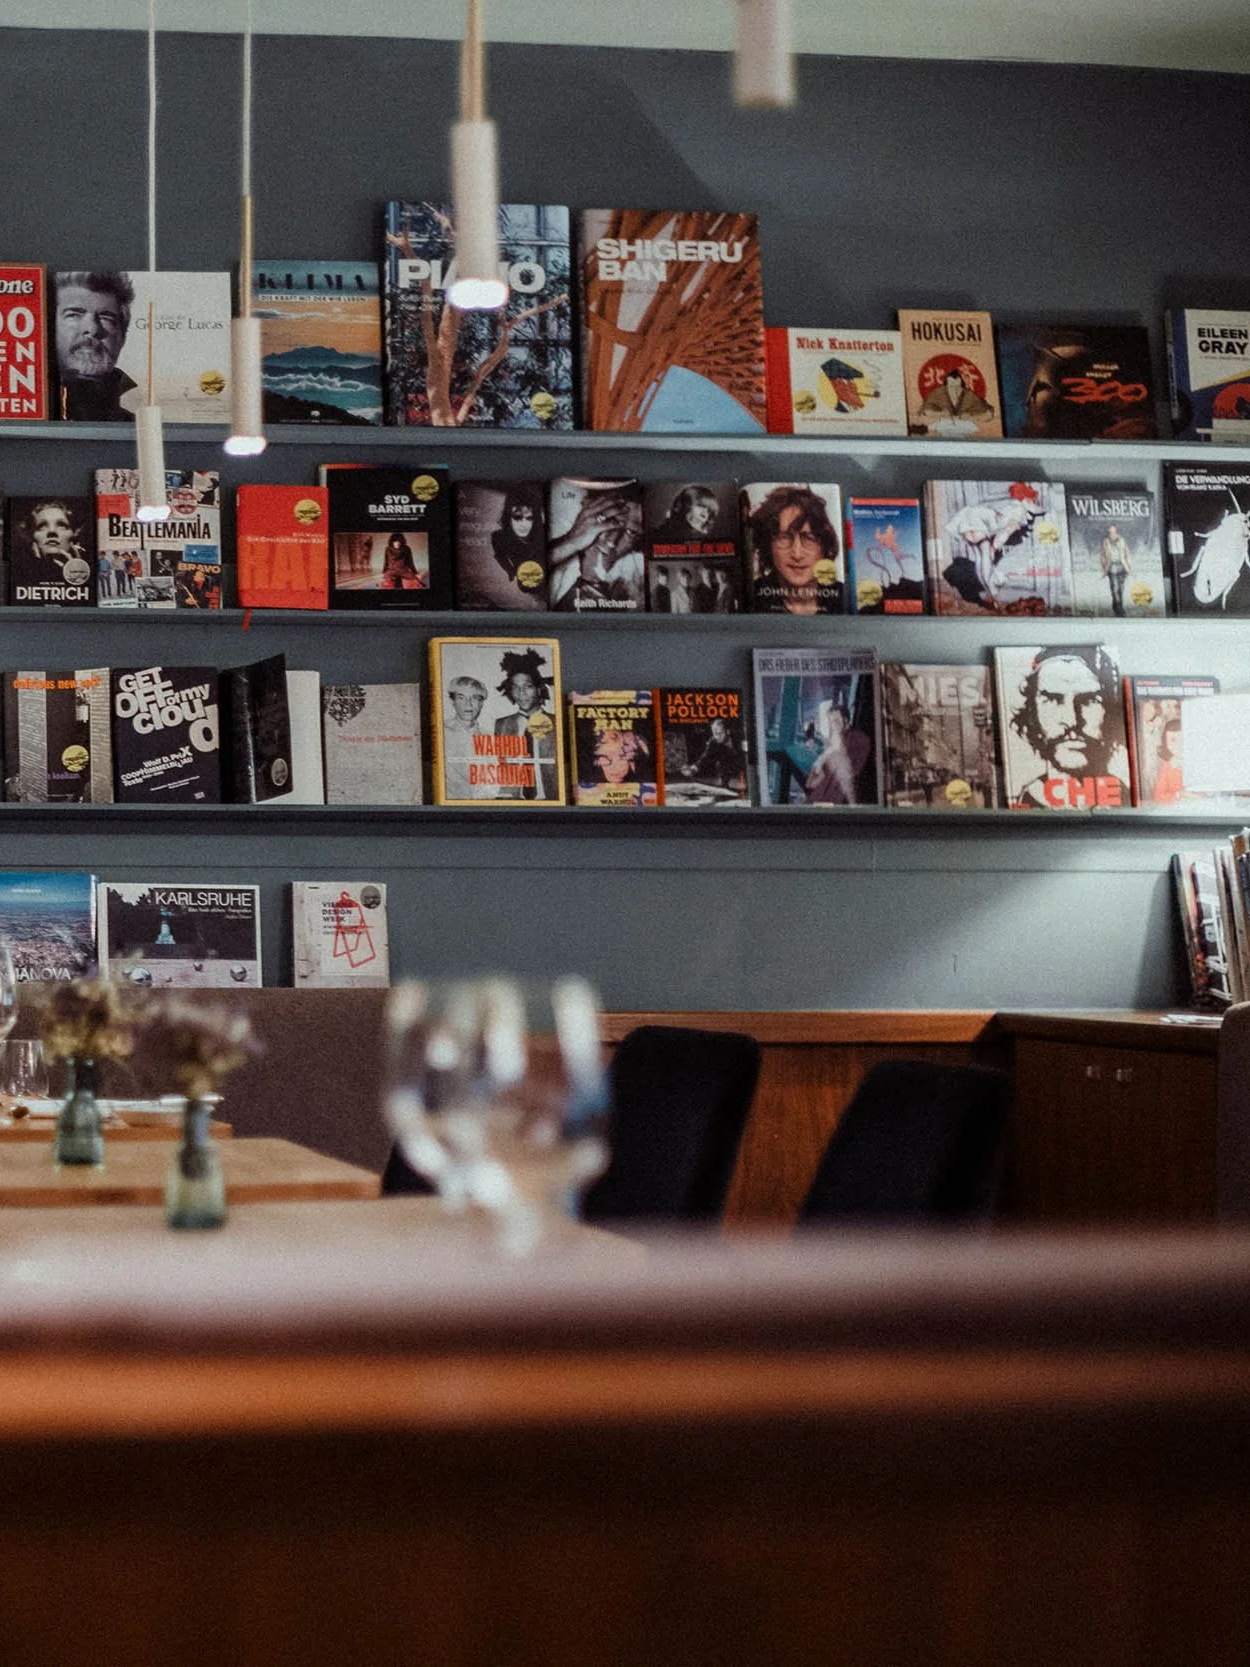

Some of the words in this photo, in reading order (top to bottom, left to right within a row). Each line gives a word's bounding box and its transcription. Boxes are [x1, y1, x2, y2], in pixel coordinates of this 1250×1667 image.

[597, 238, 743, 263] SHIGERU
[598, 260, 667, 282] BAN
[188, 318, 224, 330] Lucas
[911, 321, 983, 343] HOKUSAI
[1198, 328, 1248, 339] EILEEN
[796, 337, 825, 351] Nick
[829, 338, 895, 353] Knatterton
[1199, 340, 1249, 355] GRAY
[384, 494, 410, 504] SYD
[368, 504, 427, 514] BARRETT
[1071, 499, 1150, 517] WILSBERG
[178, 562, 222, 574] BRAVO
[16, 586, 89, 601] DIETRICH
[758, 587, 788, 597] JOHN
[791, 588, 840, 598] LENNON
[597, 598, 638, 609] Richards
[119, 667, 163, 693] GET
[116, 680, 173, 718] OFF
[181, 684, 210, 703] my
[667, 693, 739, 706] JACKSON
[577, 707, 649, 719] FACTORY
[668, 705, 739, 718] POLLOCK
[595, 719, 634, 730] MAN
[473, 735, 530, 757] WARHOL
[1043, 776, 1122, 808] CHE
[155, 892, 252, 907] KARLSRUHE
